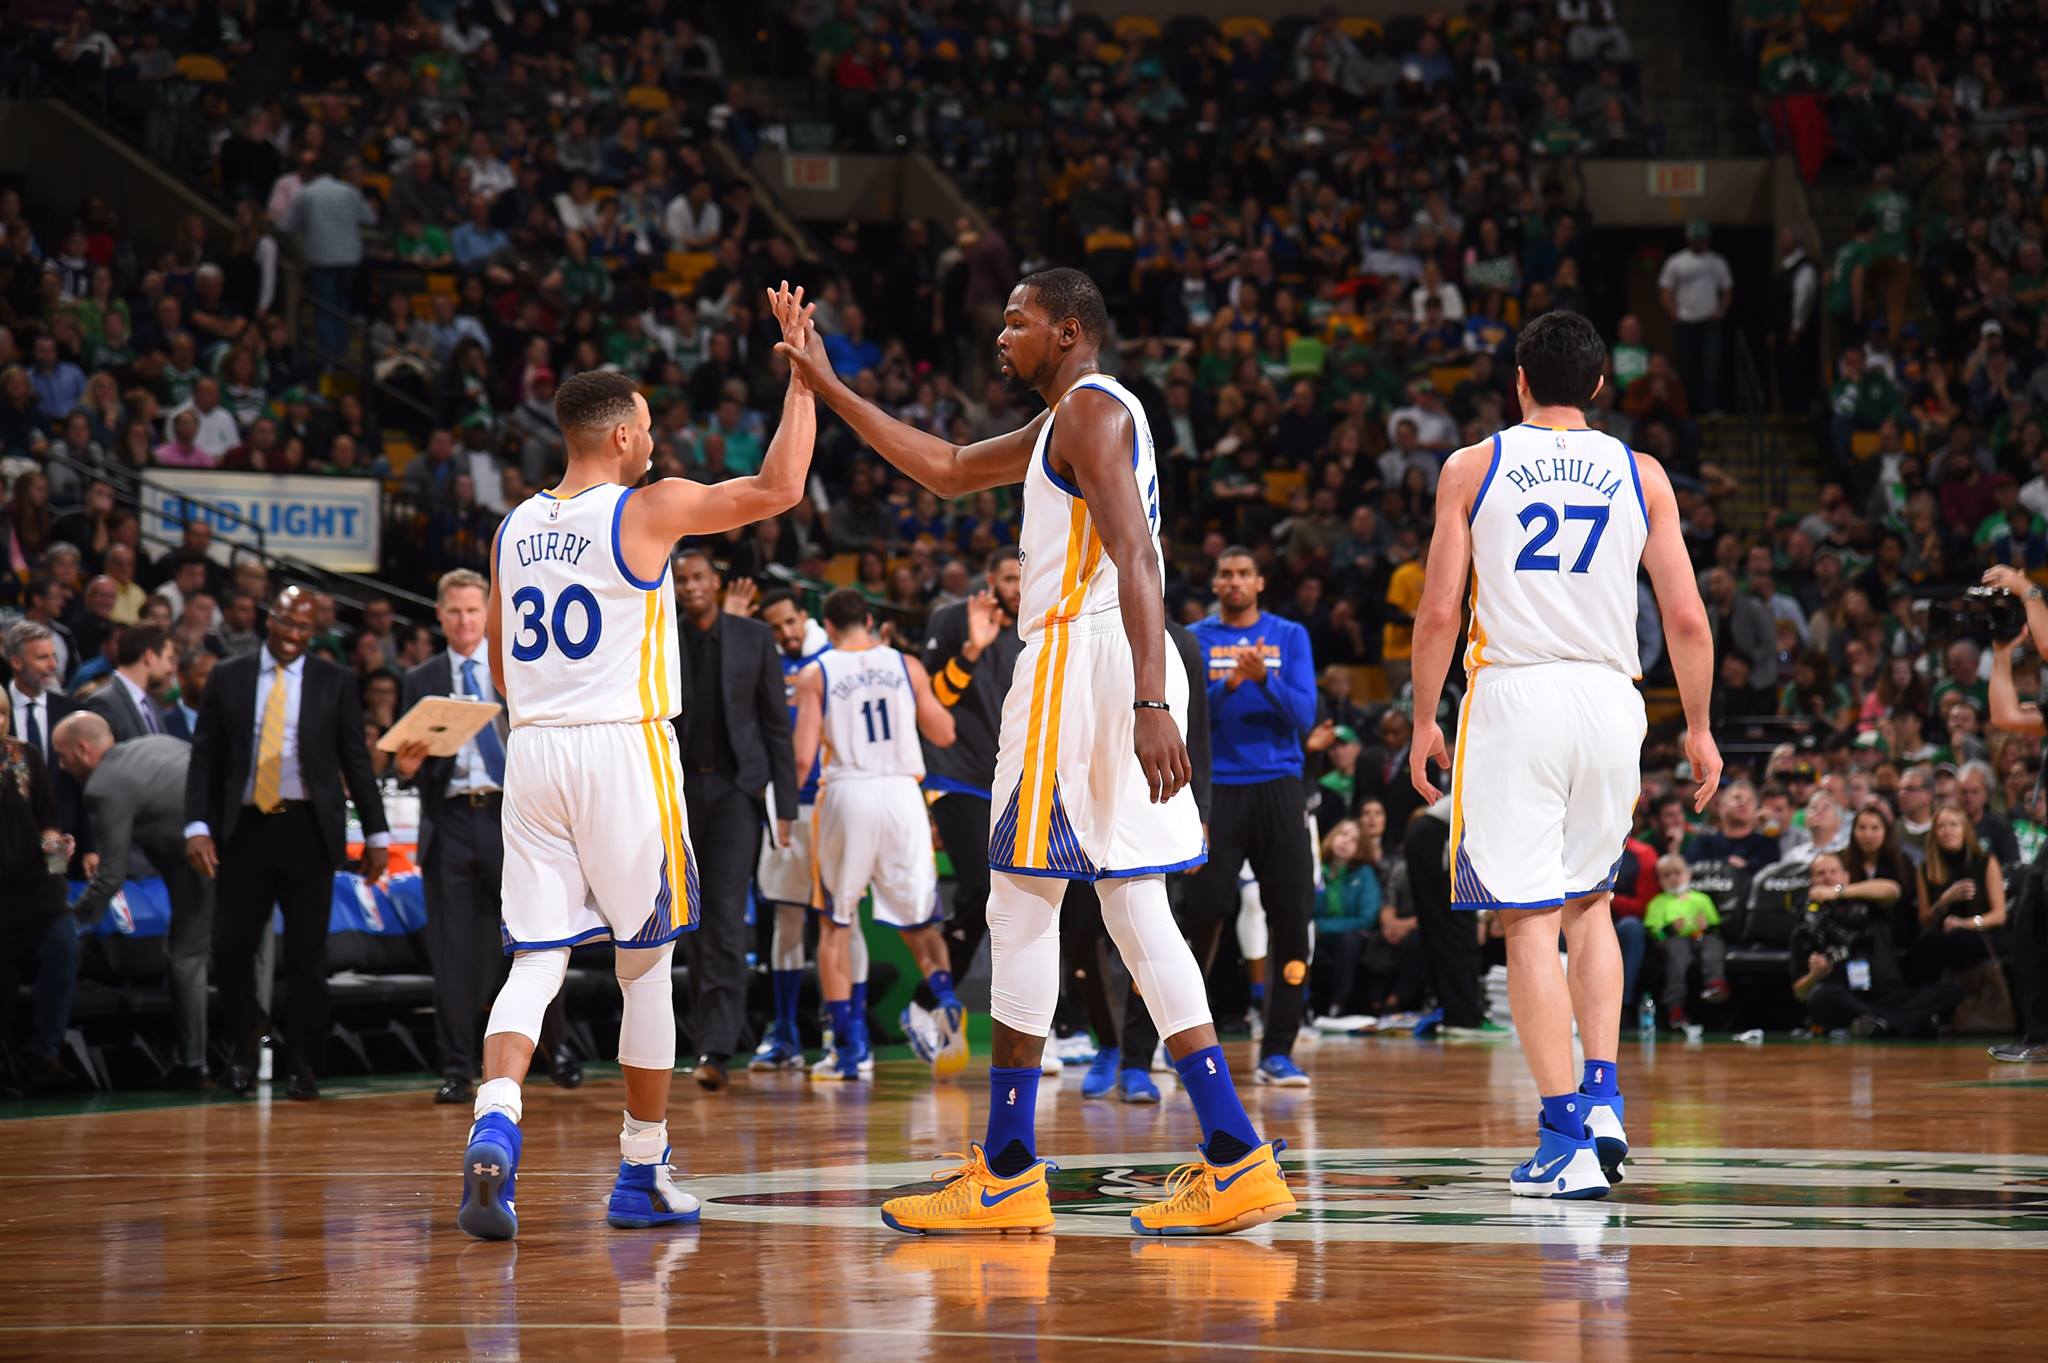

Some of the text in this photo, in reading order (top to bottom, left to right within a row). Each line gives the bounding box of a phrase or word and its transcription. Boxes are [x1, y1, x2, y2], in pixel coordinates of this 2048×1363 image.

[1506, 458, 1623, 500] PACHULIA
[248, 504, 359, 538] LIGHT
[1514, 501, 1611, 574] 27
[516, 532, 591, 567] CURRY
[511, 583, 603, 662] 30
[861, 698, 891, 742] 11
